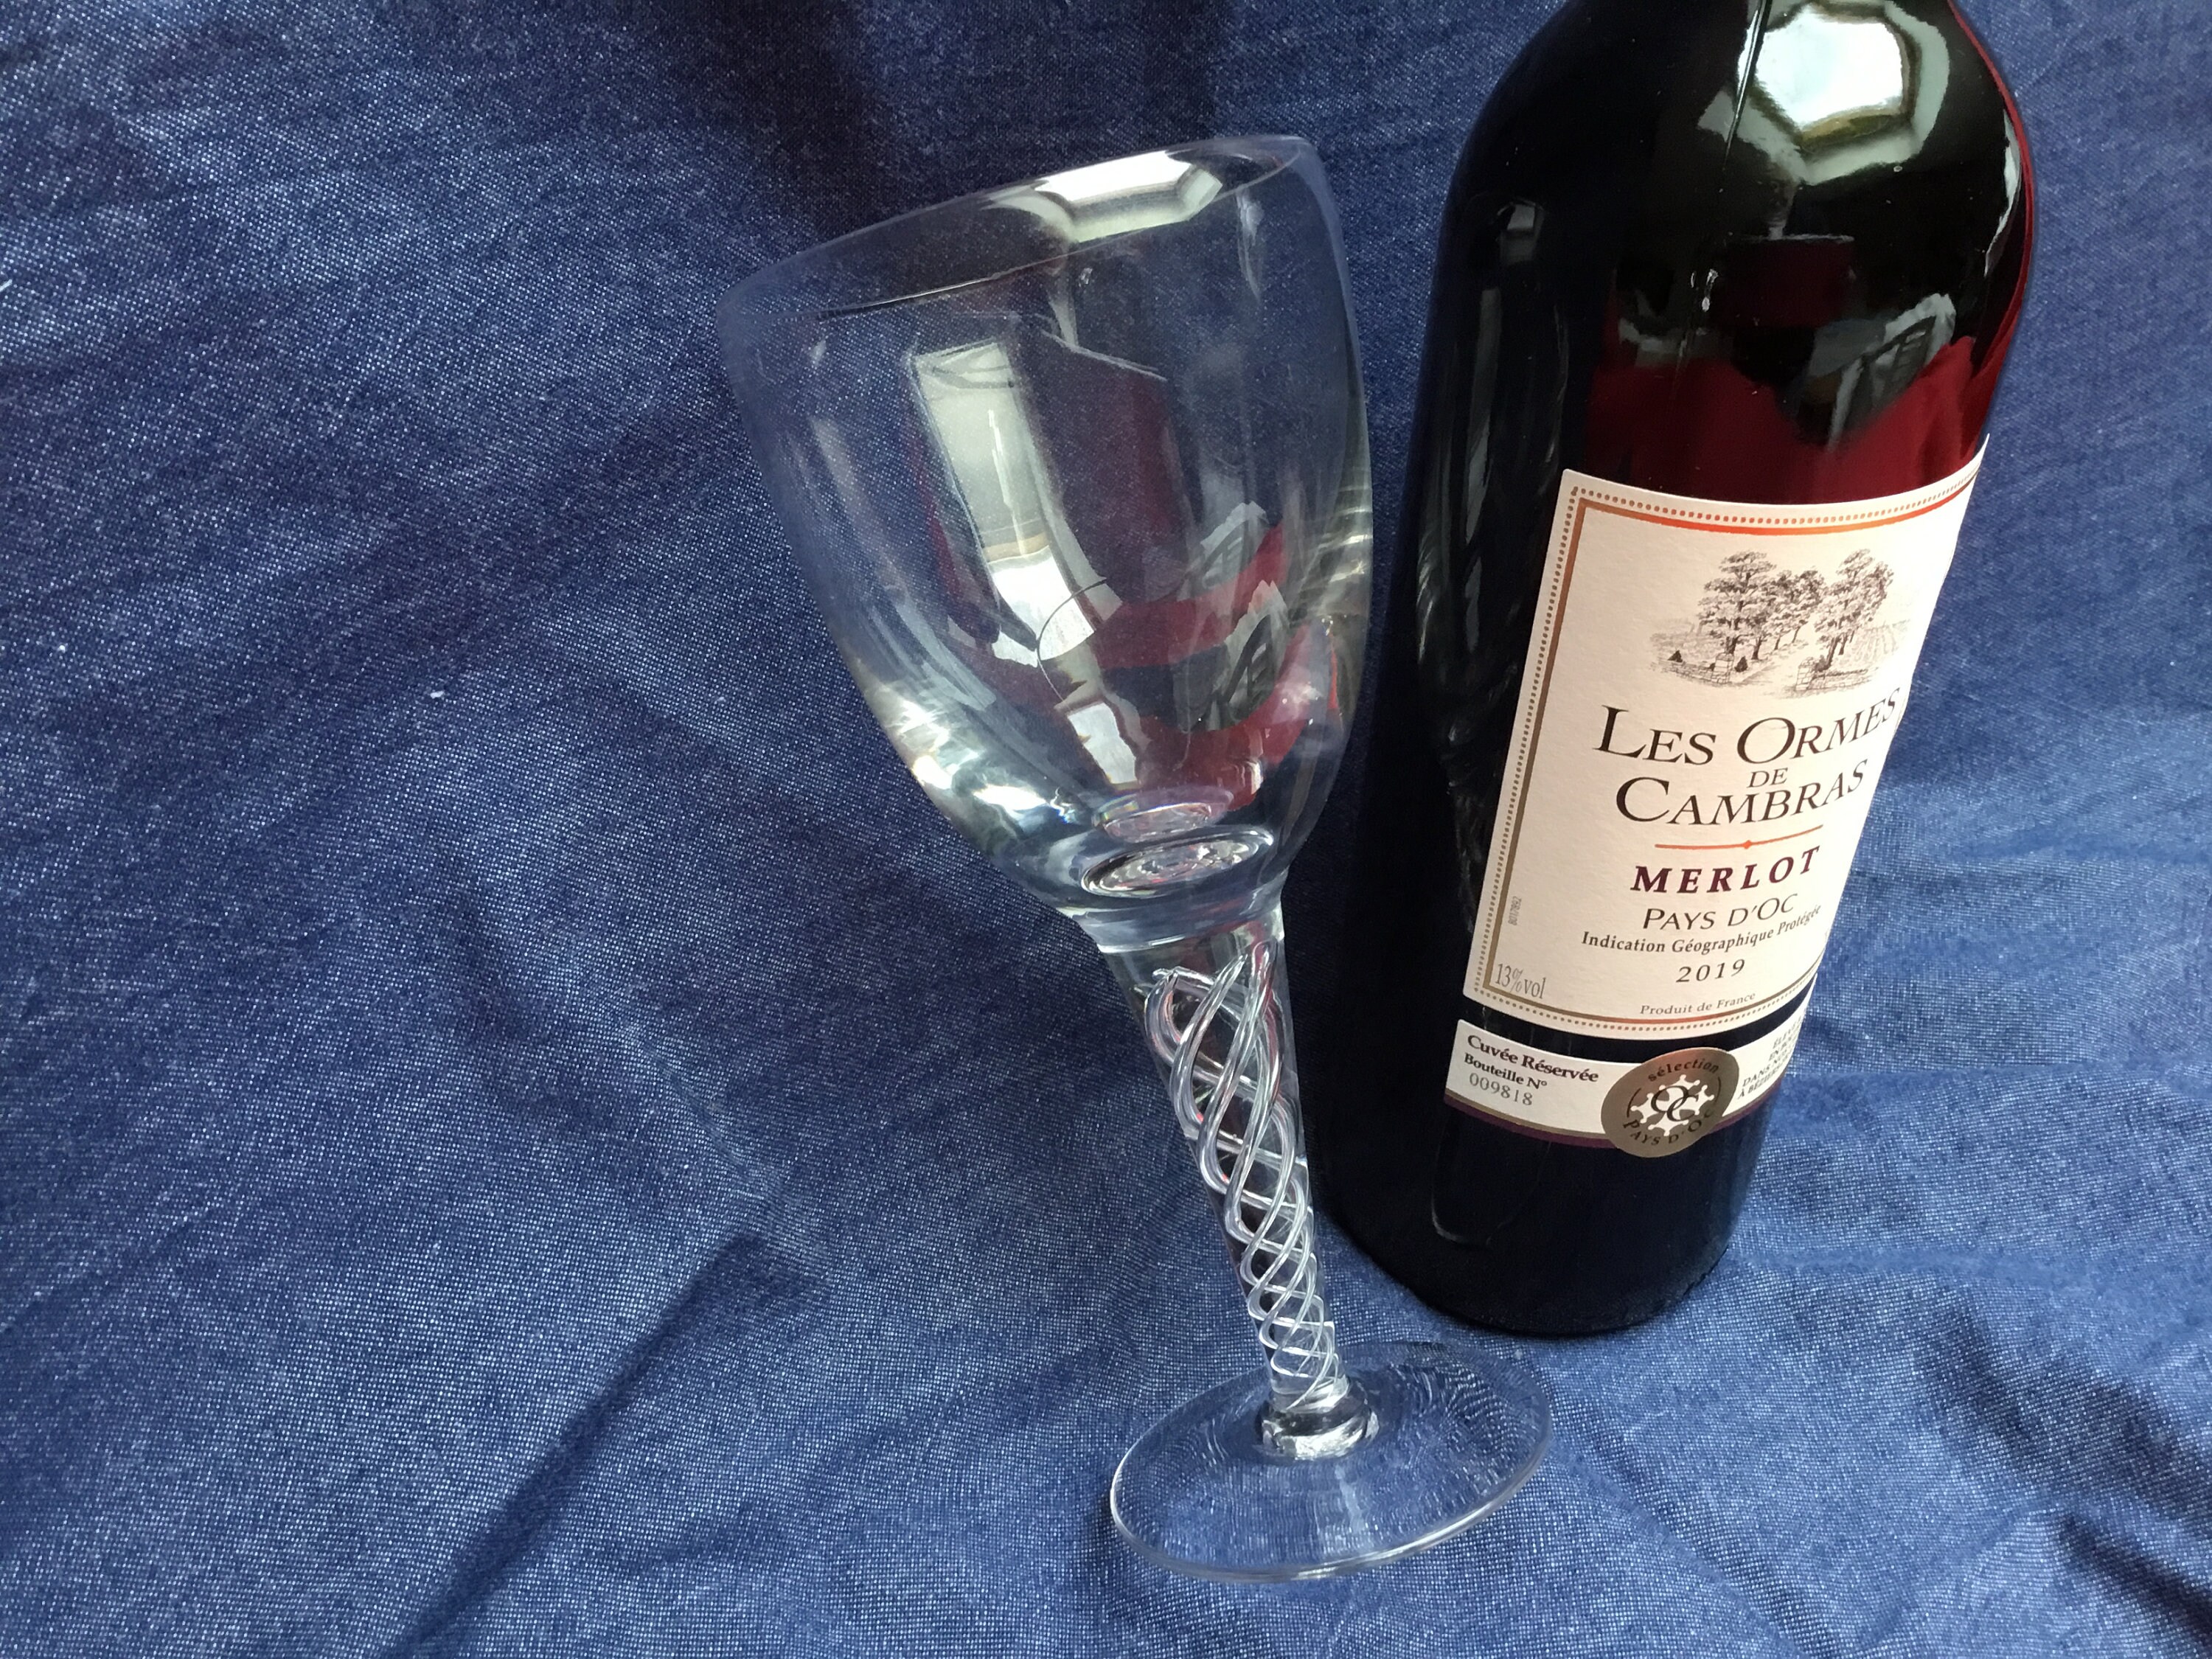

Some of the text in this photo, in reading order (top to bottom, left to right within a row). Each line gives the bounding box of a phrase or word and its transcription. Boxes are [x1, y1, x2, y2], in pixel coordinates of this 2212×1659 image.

[1593, 688, 1900, 765] LES ORMES
[1616, 759, 1867, 824] CAMBRAS
[1747, 768, 1788, 787] DE
[1630, 846, 1820, 894] MERLOT
[1643, 894, 1798, 930] PAYS D'OC
[1581, 931, 1665, 953] Indication
[1672, 928, 1773, 955] Géographique
[1777, 905, 1821, 936] Protégée
[1676, 959, 1745, 982] 2019
[1640, 993, 1756, 1015] Produit de France
[1464, 1052, 1524, 1085] Bouteille
[1467, 1034, 1599, 1082] Cuvée Réservée
[1647, 1058, 1720, 1082] sélection
[1469, 1073, 1533, 1105] 009818
[1623, 1119, 1661, 1146] PAYS
